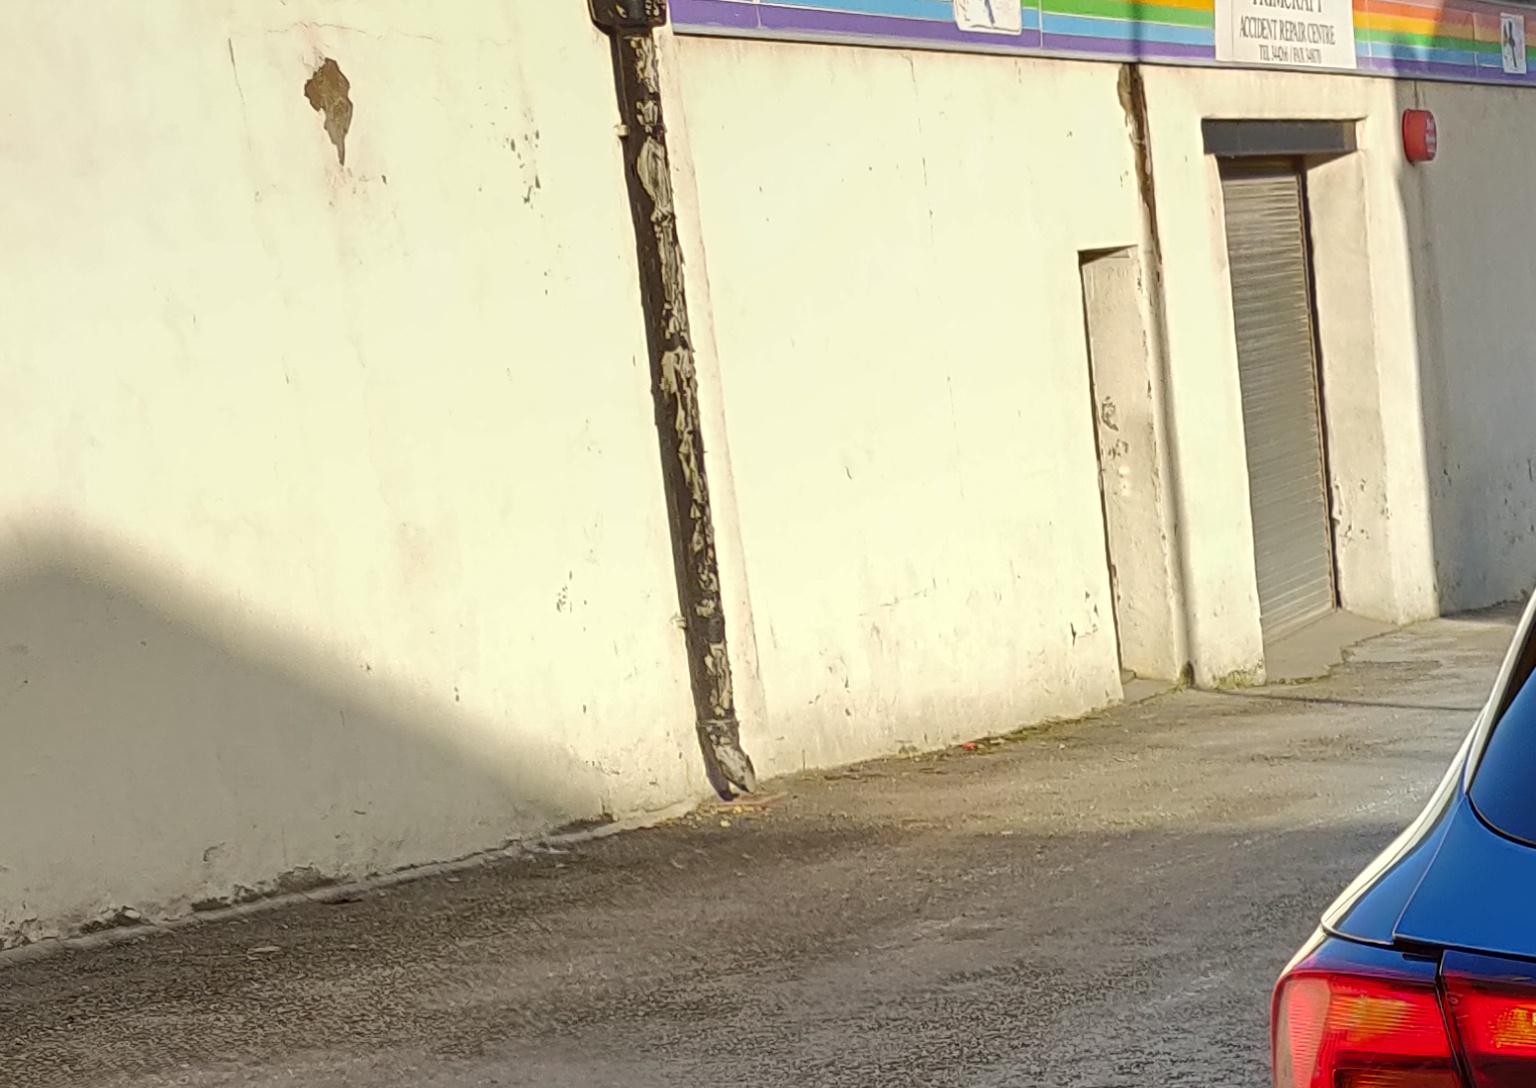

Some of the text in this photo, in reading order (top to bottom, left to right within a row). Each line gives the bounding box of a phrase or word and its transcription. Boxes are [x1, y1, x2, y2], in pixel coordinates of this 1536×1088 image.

[1240, 15, 1335, 45] ACCIDENT REPAIR CENTRE
